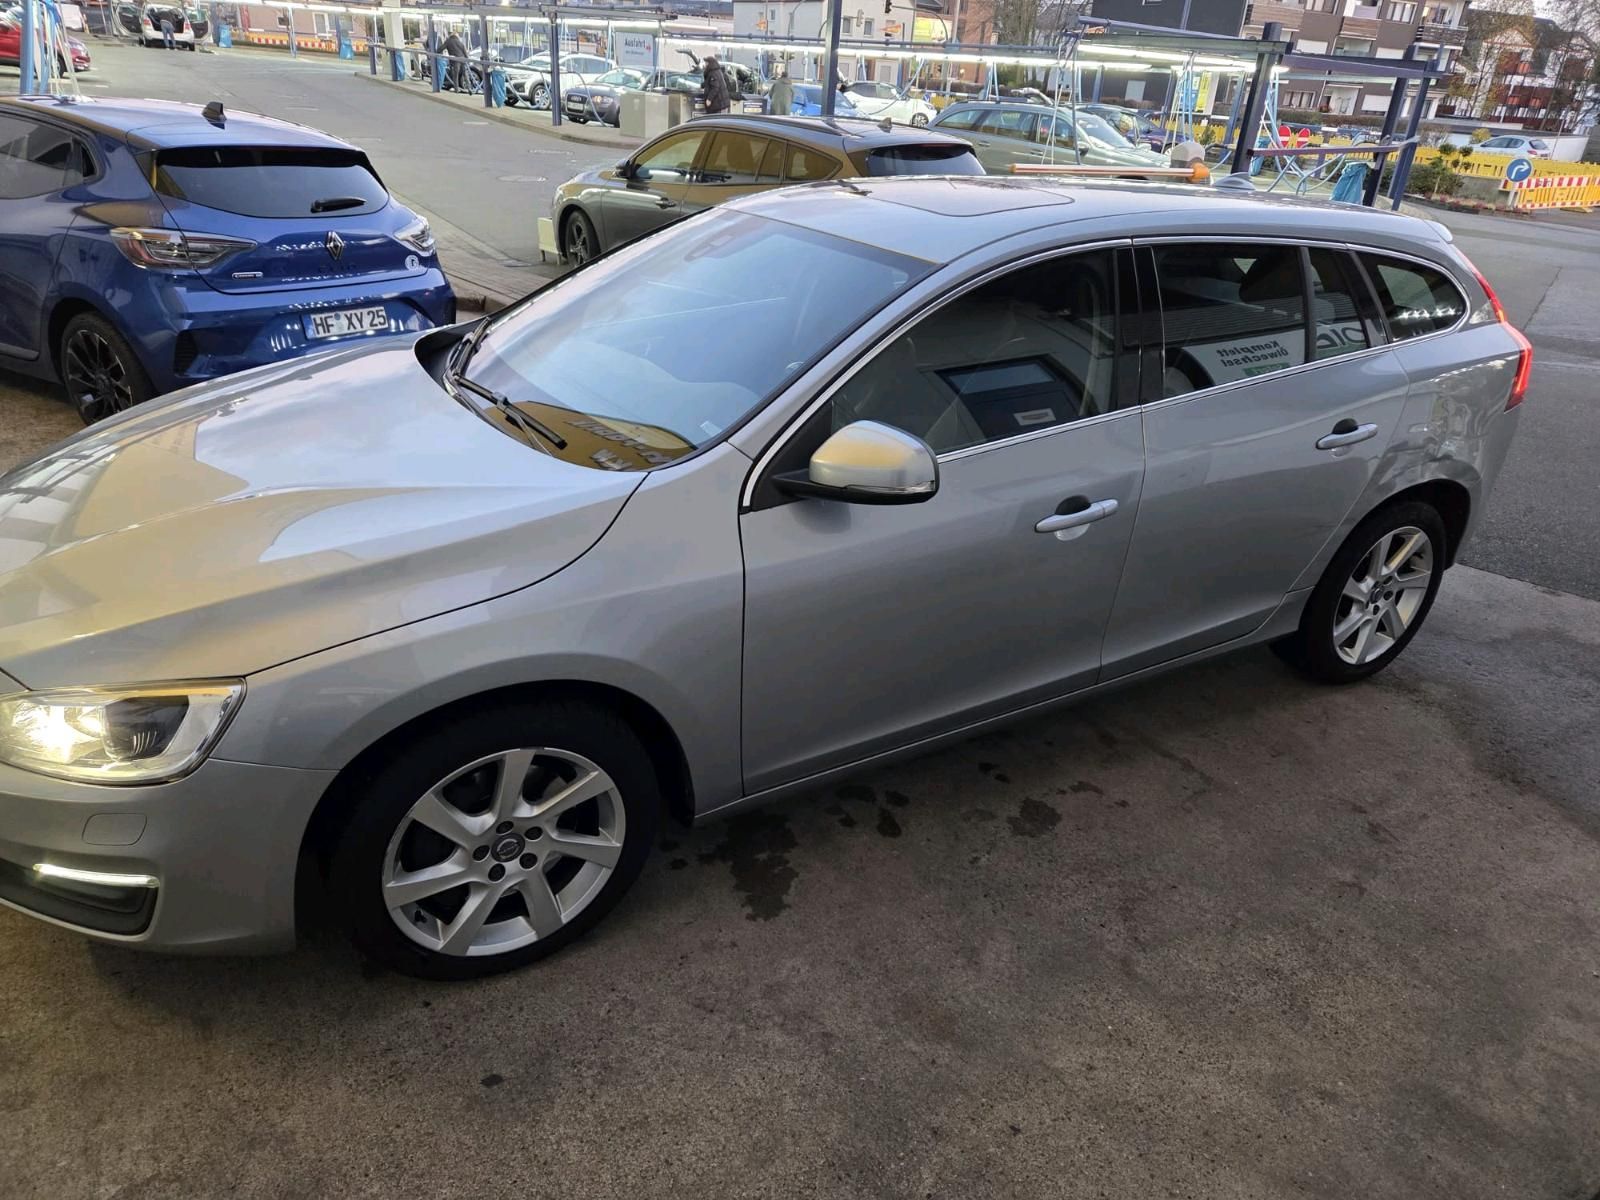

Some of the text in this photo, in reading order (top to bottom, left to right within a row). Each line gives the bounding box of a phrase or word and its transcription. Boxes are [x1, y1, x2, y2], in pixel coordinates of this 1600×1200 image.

[313, 309, 387, 335] HF XY 25
